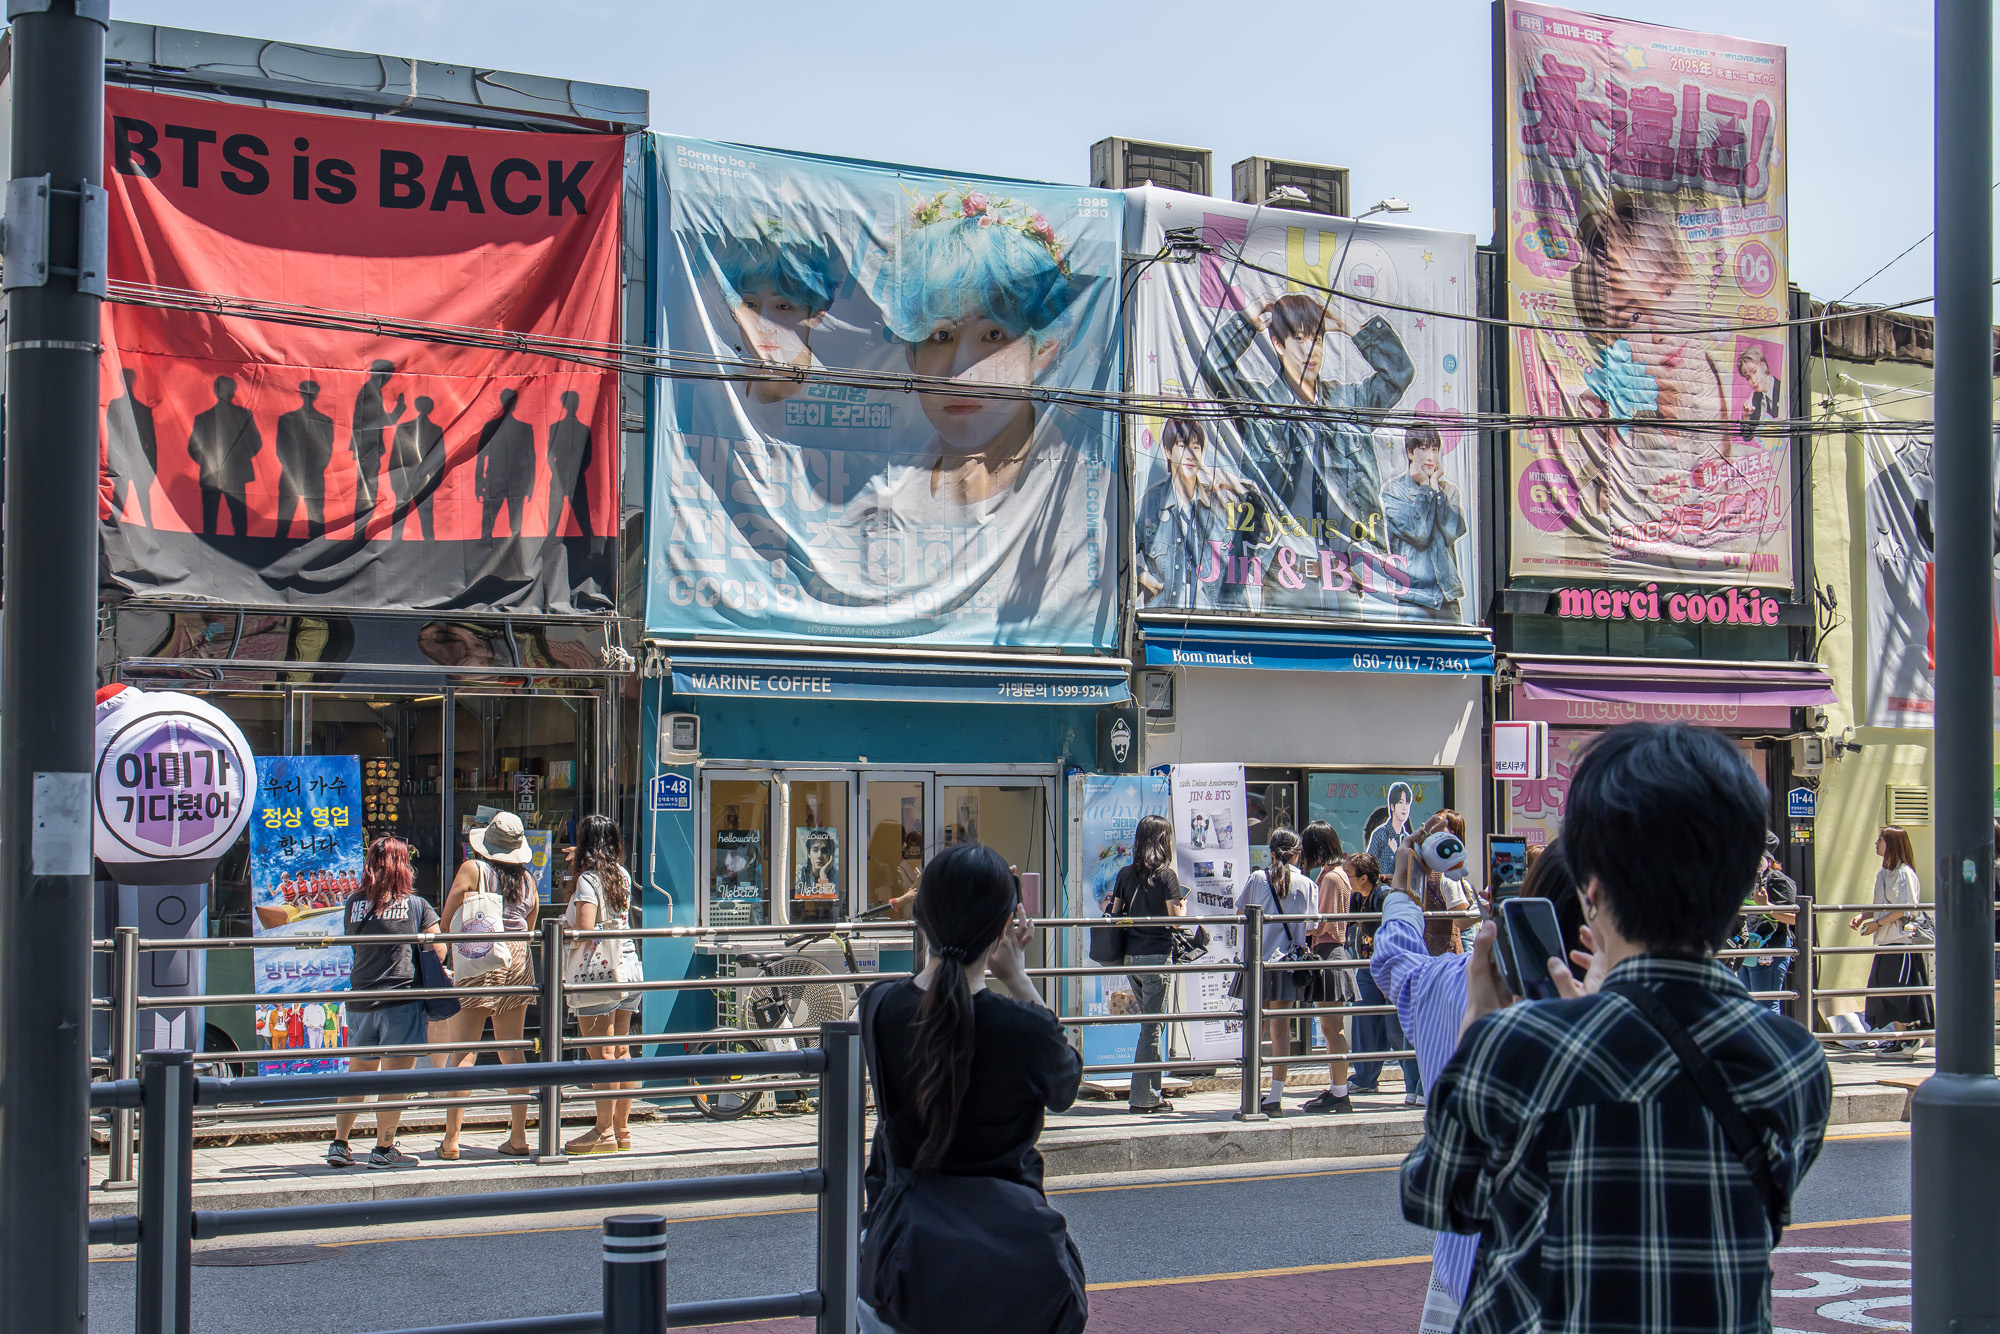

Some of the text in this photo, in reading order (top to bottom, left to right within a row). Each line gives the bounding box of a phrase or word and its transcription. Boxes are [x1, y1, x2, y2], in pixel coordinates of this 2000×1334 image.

[1650, 42, 1668, 51] JIMIN
[1669, 45, 1687, 53] CAFE
[1687, 47, 1708, 57] EVENT
[1670, 57, 1713, 77] 2025年
[112, 115, 595, 216] BTS is BACK
[676, 145, 757, 170] Born to be a
[677, 157, 748, 179] Superstar
[1077, 198, 1109, 207] 1995
[1077, 208, 1109, 218] 1230
[1678, 211, 1719, 226] FOREVER
[1743, 204, 1767, 219] EVER
[1767, 218, 1781, 229] END
[1741, 254, 1770, 282] 06
[1520, 291, 1557, 310] キラキラ
[1737, 305, 1778, 320] キラキラ
[787, 402, 891, 428] 많이 보라해
[670, 432, 851, 513] 태형아
[1086, 448, 1100, 591] WELCOME BACK
[1225, 501, 1382, 543] 12 years of
[669, 506, 788, 578] 전역
[1196, 540, 1412, 596] Jin & BTS
[1746, 554, 1780, 573] JIMIN
[668, 575, 851, 616] GOOD BYE!
[949, 591, 998, 620] 추억
[1557, 581, 1781, 627] merci cookie
[807, 625, 828, 634] LOVE
[830, 626, 855, 635] FROM
[856, 627, 890, 637] CHINESE
[892, 628, 913, 638] FANS
[924, 630, 950, 639] CHINA
[951, 631, 973, 639] VBAR
[1172, 648, 1473, 672] Bom market 050-7017-73461
[691, 673, 832, 693] MARINE COFFEE
[997, 682, 1110, 699] 가맹문의 1599-9341
[116, 749, 231, 790] 아미가
[1495, 761, 1527, 771] 메르시쿠키
[263, 775, 347, 798] 우리 가수
[1208, 779, 1239, 789] Anniversary
[1325, 783, 1428, 799] BTS AY
[116, 791, 230, 824] 기다렸어
[1188, 790, 1232, 804] JIN & BTS
[1791, 793, 1814, 804] 11-44
[262, 806, 349, 829] 정상 영업
[278, 834, 337, 857] 합니다
[526, 836, 547, 845] COME
[843, 959, 876, 967] SSUNG
